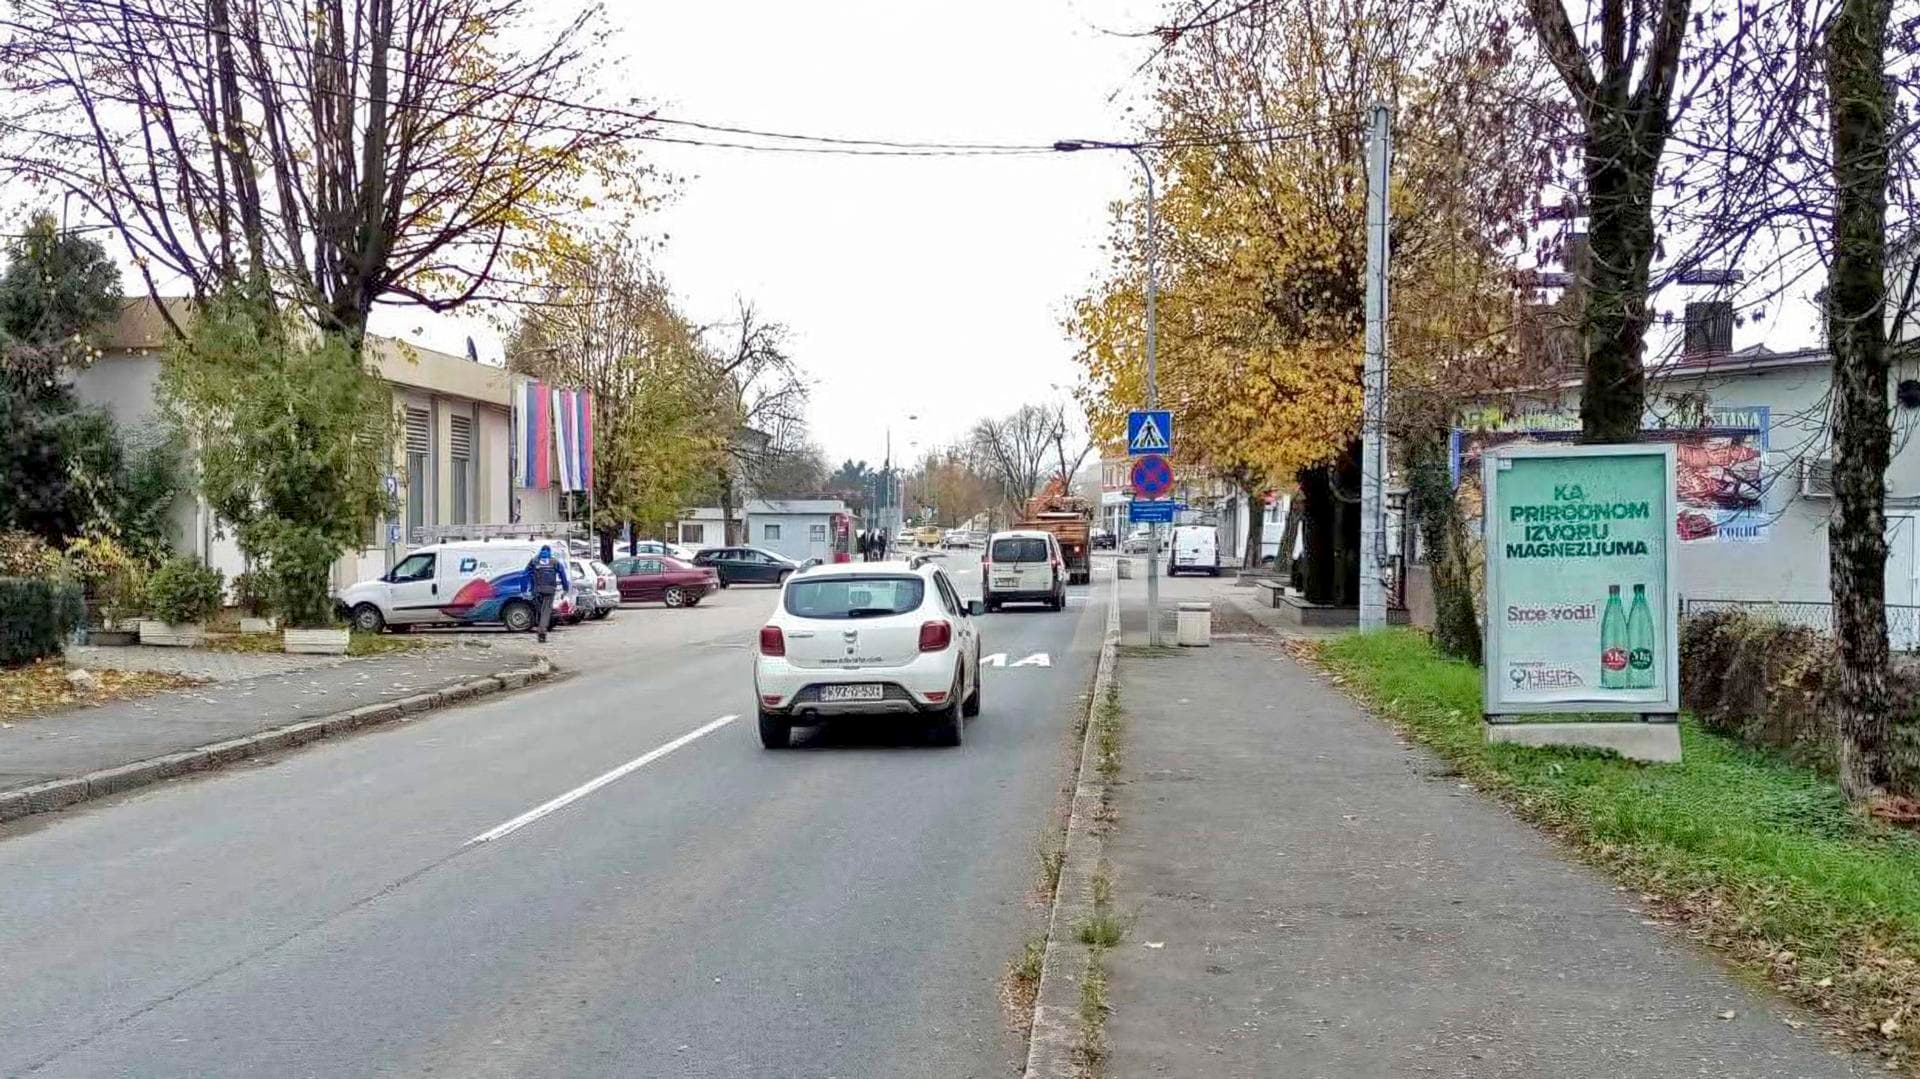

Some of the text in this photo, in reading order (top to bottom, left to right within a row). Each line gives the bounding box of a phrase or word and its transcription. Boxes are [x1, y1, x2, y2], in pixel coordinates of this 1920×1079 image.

[1554, 484, 1584, 501] KA
[1509, 501, 1650, 522] PRIRODNOM
[1525, 523, 1609, 542] IZVORU
[1506, 540, 1649, 559] MAGNEZIJUMA
[1507, 604, 1597, 622] Srce vodi!
